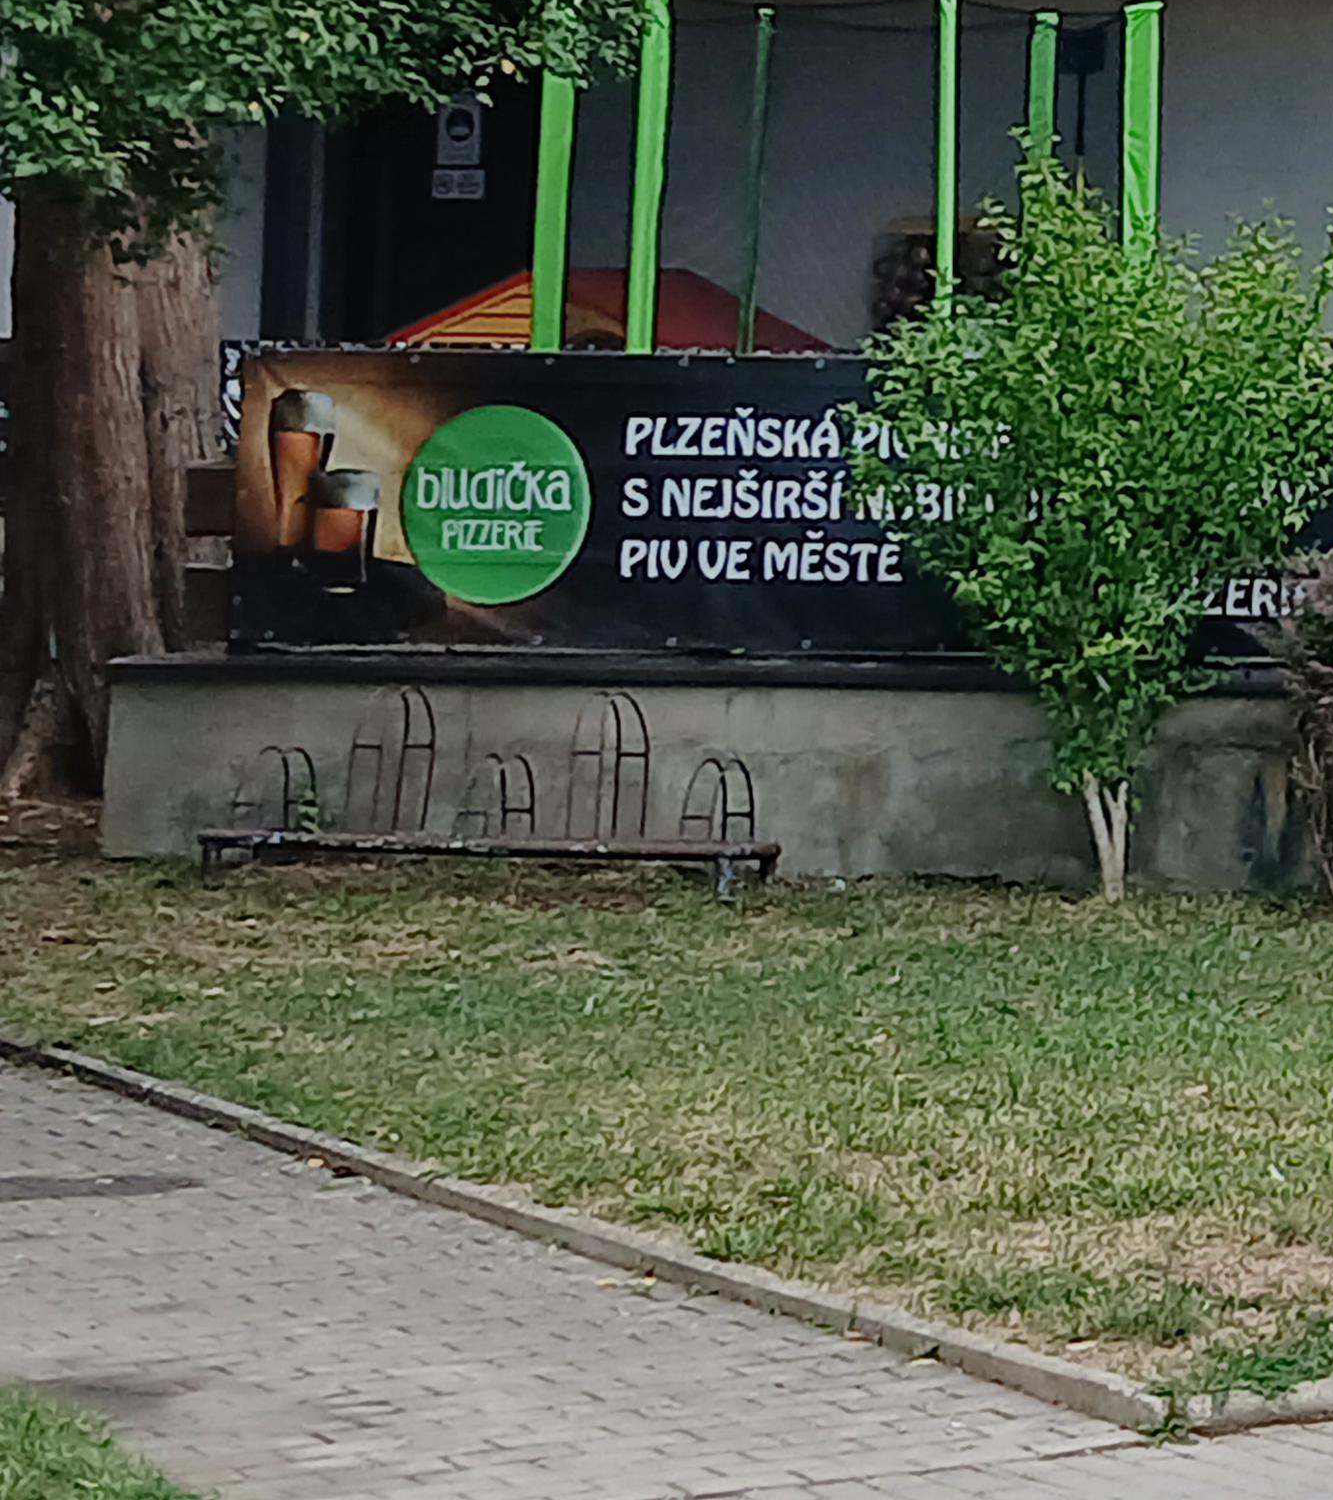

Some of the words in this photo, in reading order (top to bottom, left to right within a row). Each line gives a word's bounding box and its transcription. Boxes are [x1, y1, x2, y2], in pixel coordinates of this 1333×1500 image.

[625, 406, 841, 459] PLZEŇSKÁ
[416, 460, 573, 512] bludička
[622, 478, 649, 518] S
[661, 468, 847, 520] NEJŠIRŠÍ
[441, 518, 545, 552] PIZZERIE
[620, 538, 689, 580] PIV
[697, 540, 752, 581] VE
[763, 529, 903, 583] MĚSTĚ
